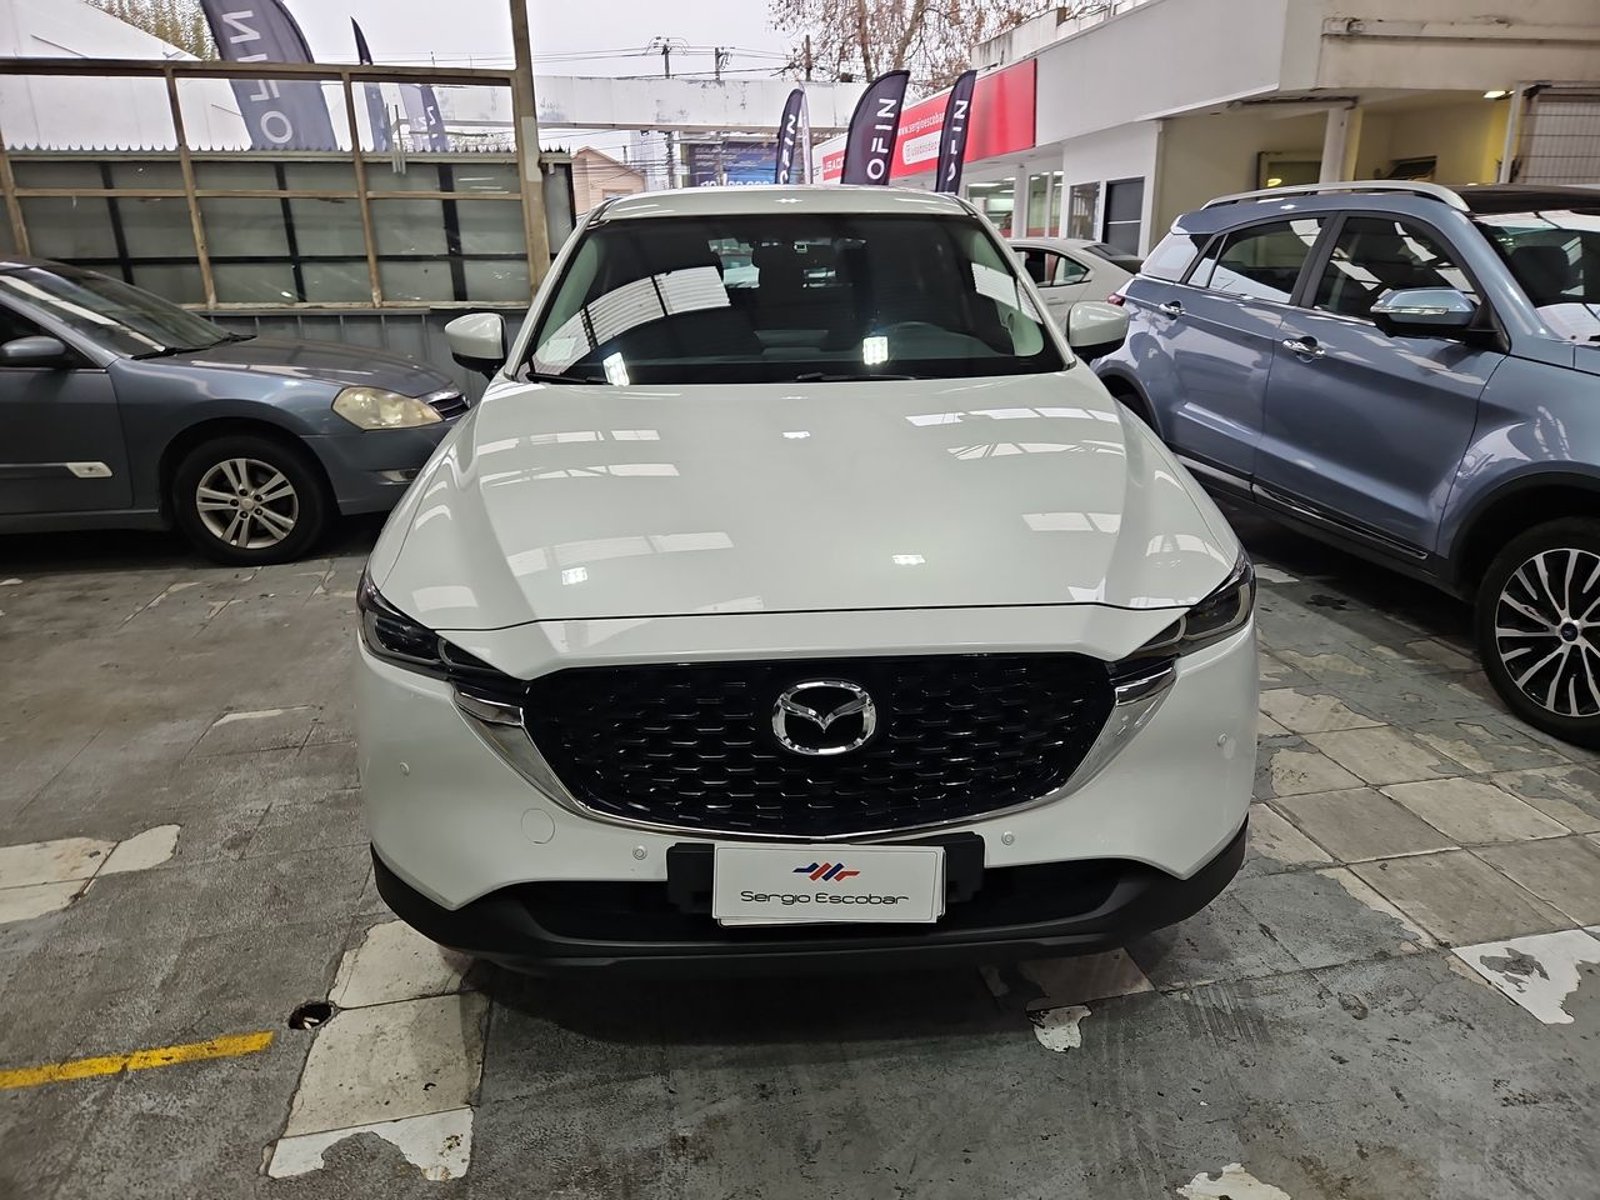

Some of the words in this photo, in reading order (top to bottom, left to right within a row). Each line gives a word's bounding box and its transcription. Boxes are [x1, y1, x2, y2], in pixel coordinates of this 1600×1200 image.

[866, 98, 897, 180] OFIN
[740, 890, 811, 906] Sergio
[815, 892, 910, 905] Escobar
